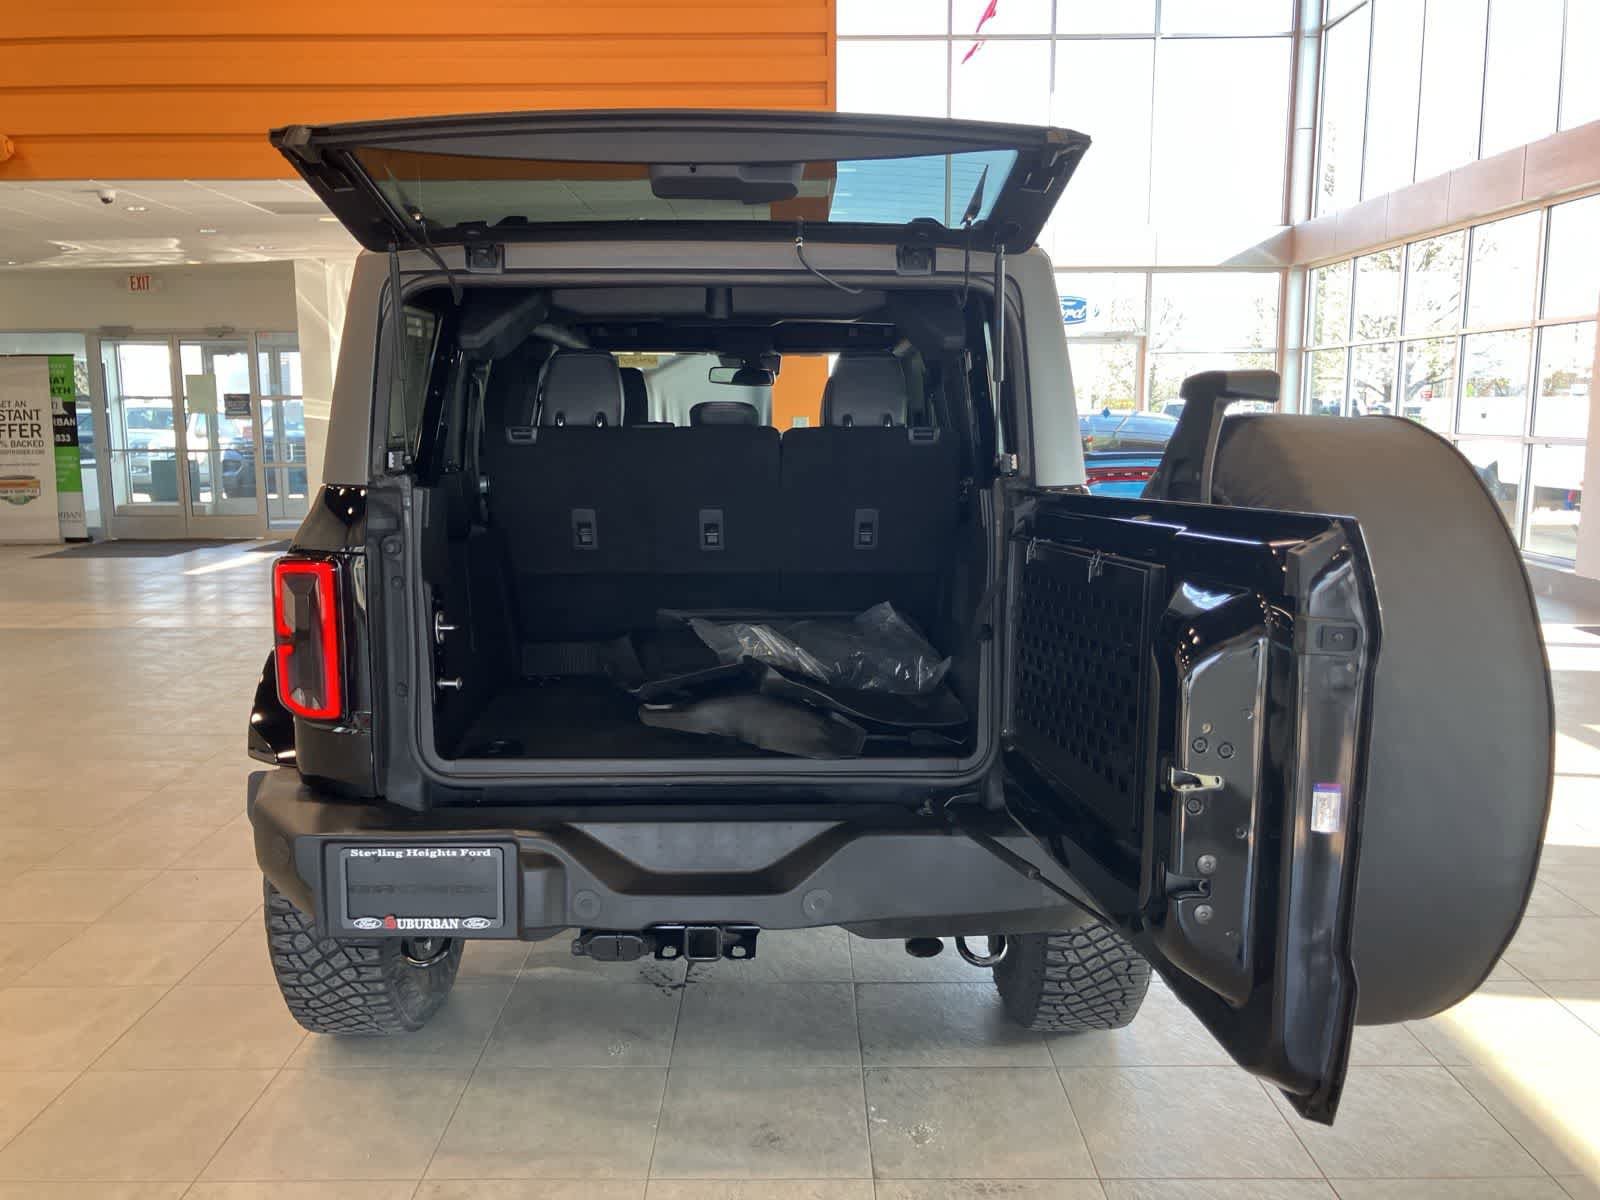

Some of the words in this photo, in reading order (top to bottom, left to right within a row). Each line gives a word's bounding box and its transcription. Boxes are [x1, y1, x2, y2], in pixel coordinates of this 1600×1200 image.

[130, 275, 150, 291] EXIT
[350, 849, 403, 859] Sterling
[406, 849, 457, 859] Heights
[459, 849, 491, 857] Ford
[384, 914, 460, 930] SUBURBAN
